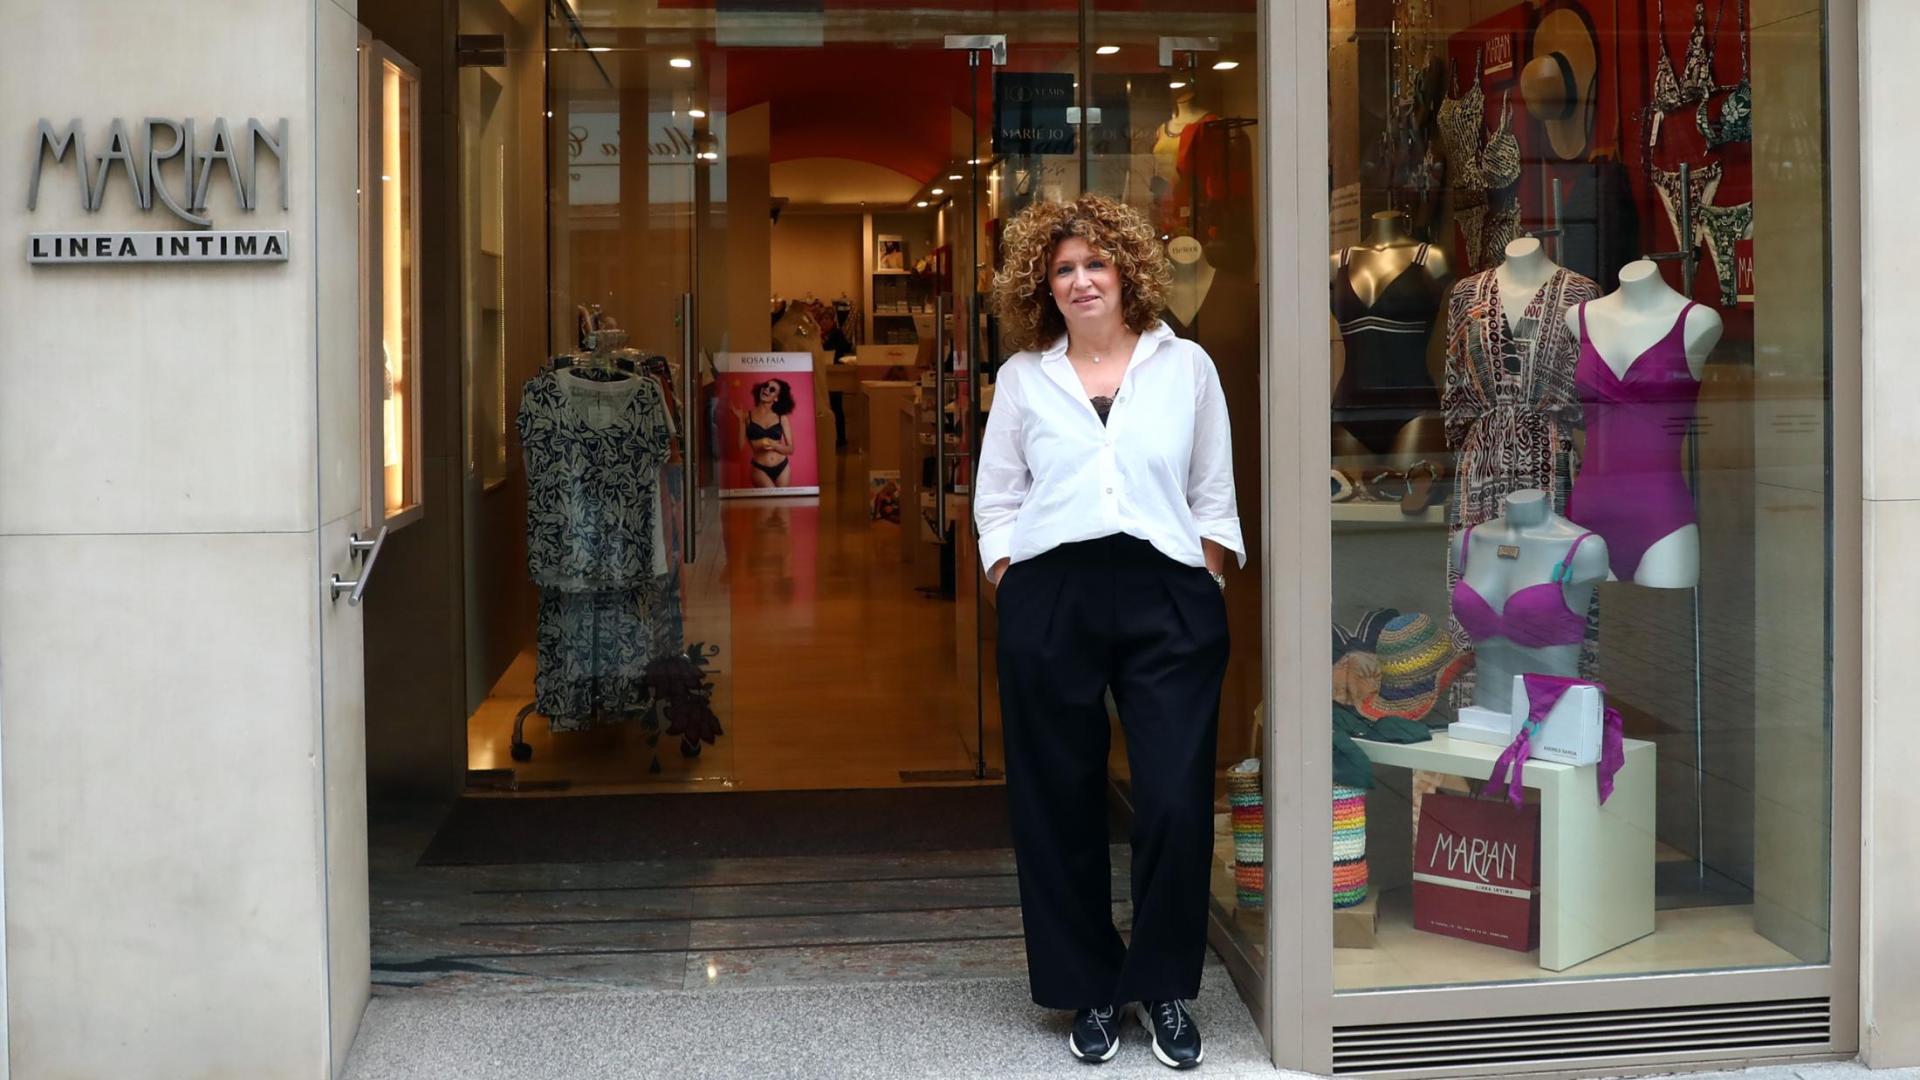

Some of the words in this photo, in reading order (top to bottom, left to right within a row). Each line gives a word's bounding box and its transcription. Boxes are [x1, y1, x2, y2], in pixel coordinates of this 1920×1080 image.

[1002, 128, 1042, 140] MARIE
[1048, 128, 1064, 140] JO
[26, 117, 289, 228] MARIAN
[33, 237, 138, 258] LINEA
[156, 235, 283, 256] INTIMA
[741, 356, 764, 365] ROSA
[766, 356, 785, 365] FAIA
[1430, 833, 1517, 883] MARIAN
